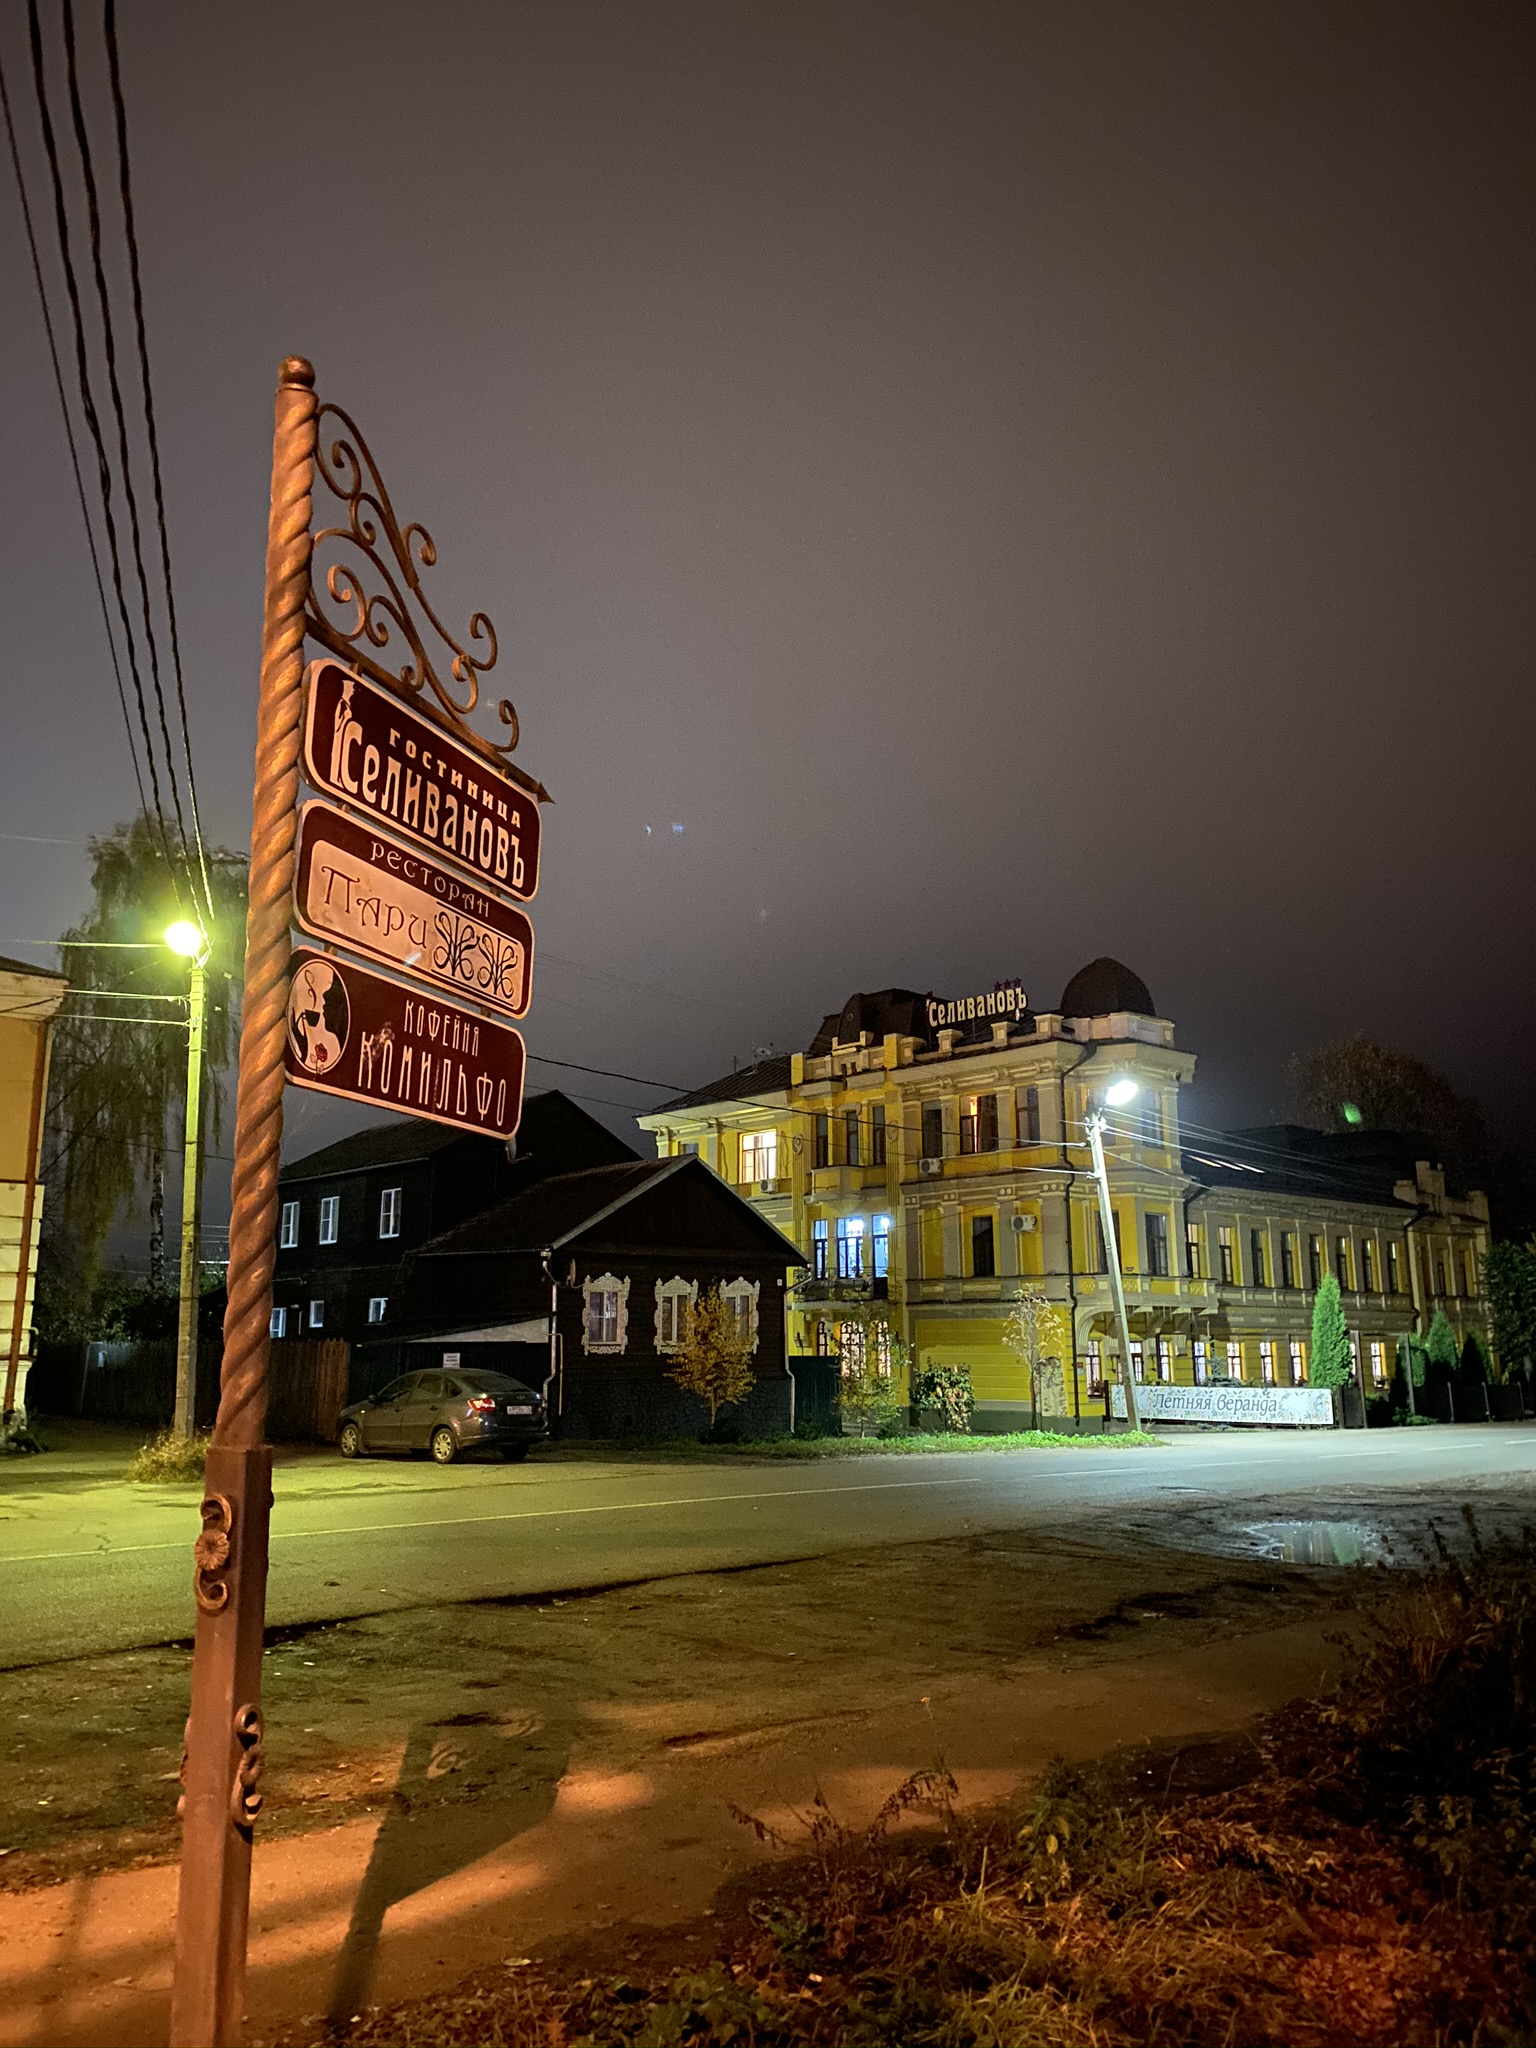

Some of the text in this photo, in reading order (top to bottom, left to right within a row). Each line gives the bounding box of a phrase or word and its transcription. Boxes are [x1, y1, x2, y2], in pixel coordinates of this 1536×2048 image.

[340, 720, 525, 889] Селивановъ
[403, 999, 480, 1057] КОФЕЙНЯ
[928, 987, 1027, 1028] Селивановъ
[357, 1031, 507, 1127] КОМИЛЬФО
[1153, 1393, 1278, 1417] Летняя веранда
